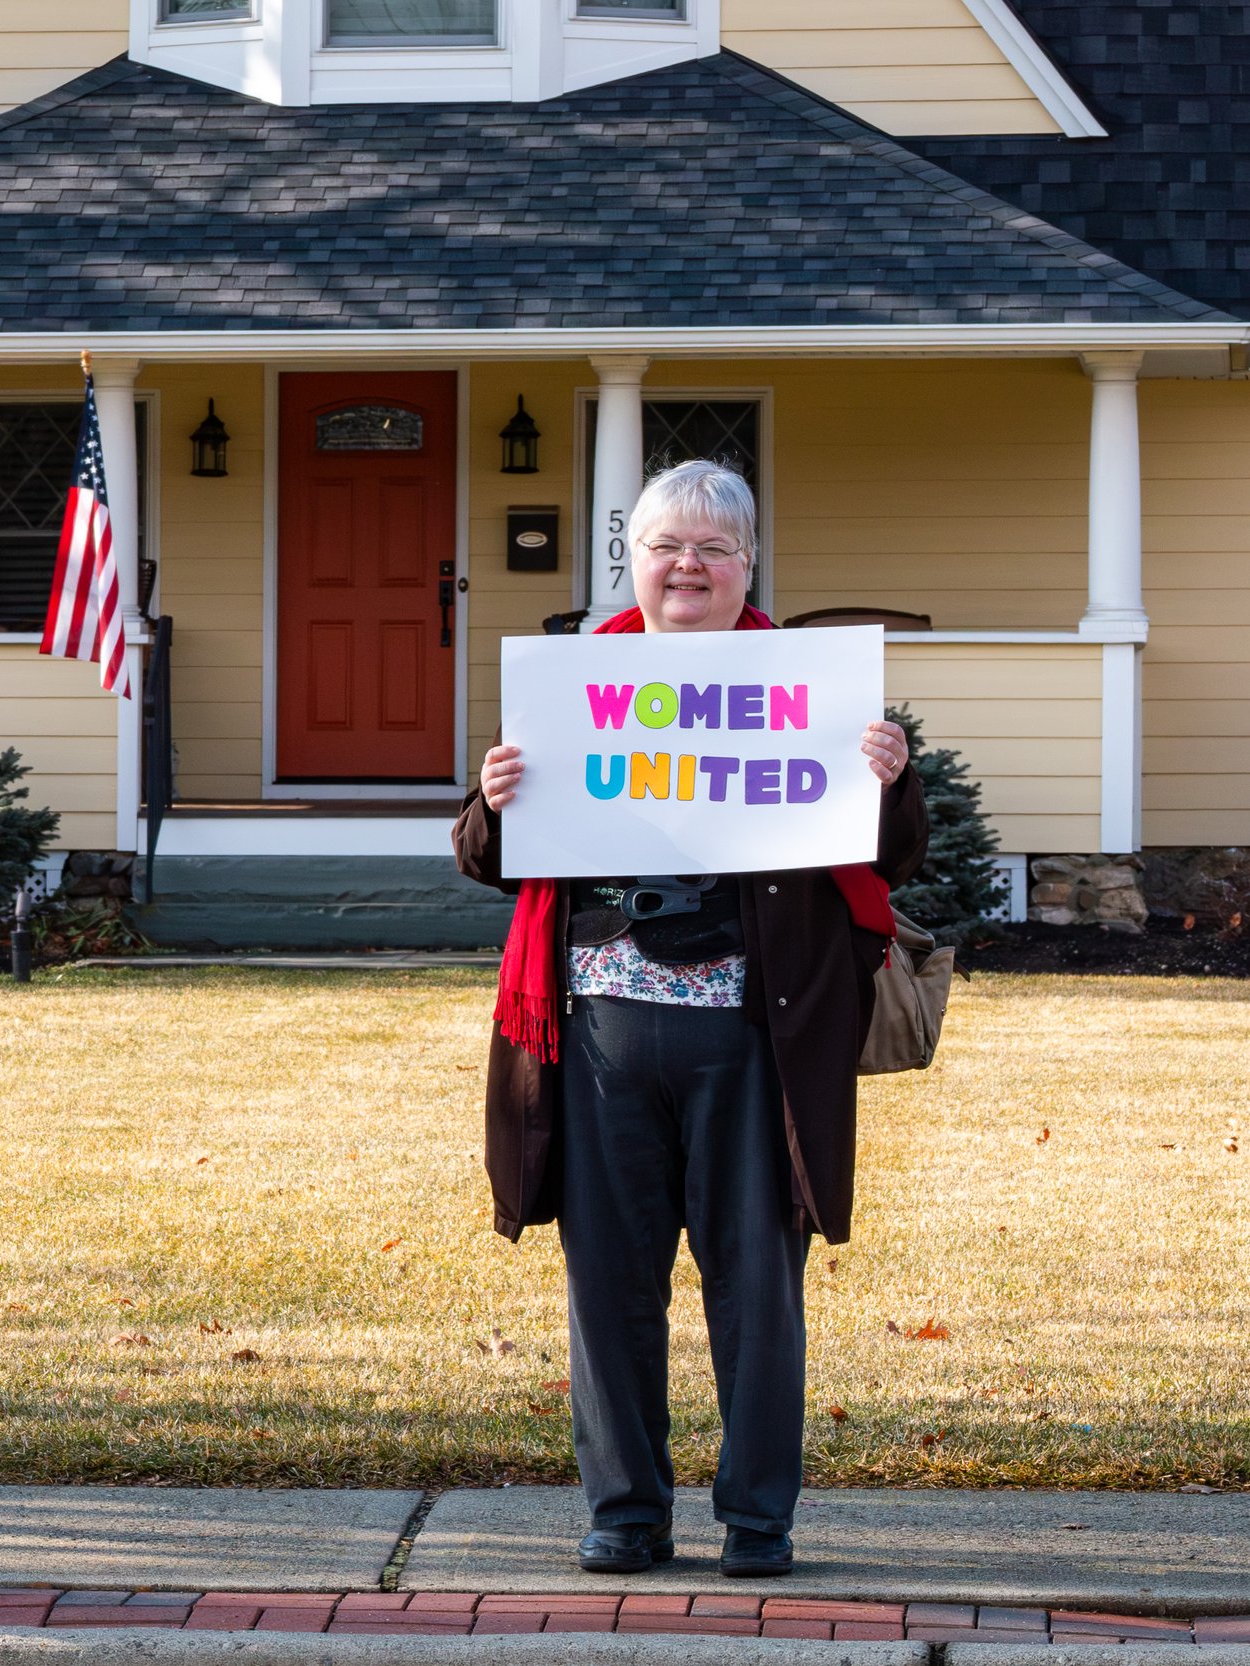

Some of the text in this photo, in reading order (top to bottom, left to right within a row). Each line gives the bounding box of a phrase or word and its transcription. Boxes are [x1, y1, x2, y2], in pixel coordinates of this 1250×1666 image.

[608, 509, 625, 591] 507
[585, 682, 809, 731] WOMEN
[585, 752, 828, 806] UNITED
